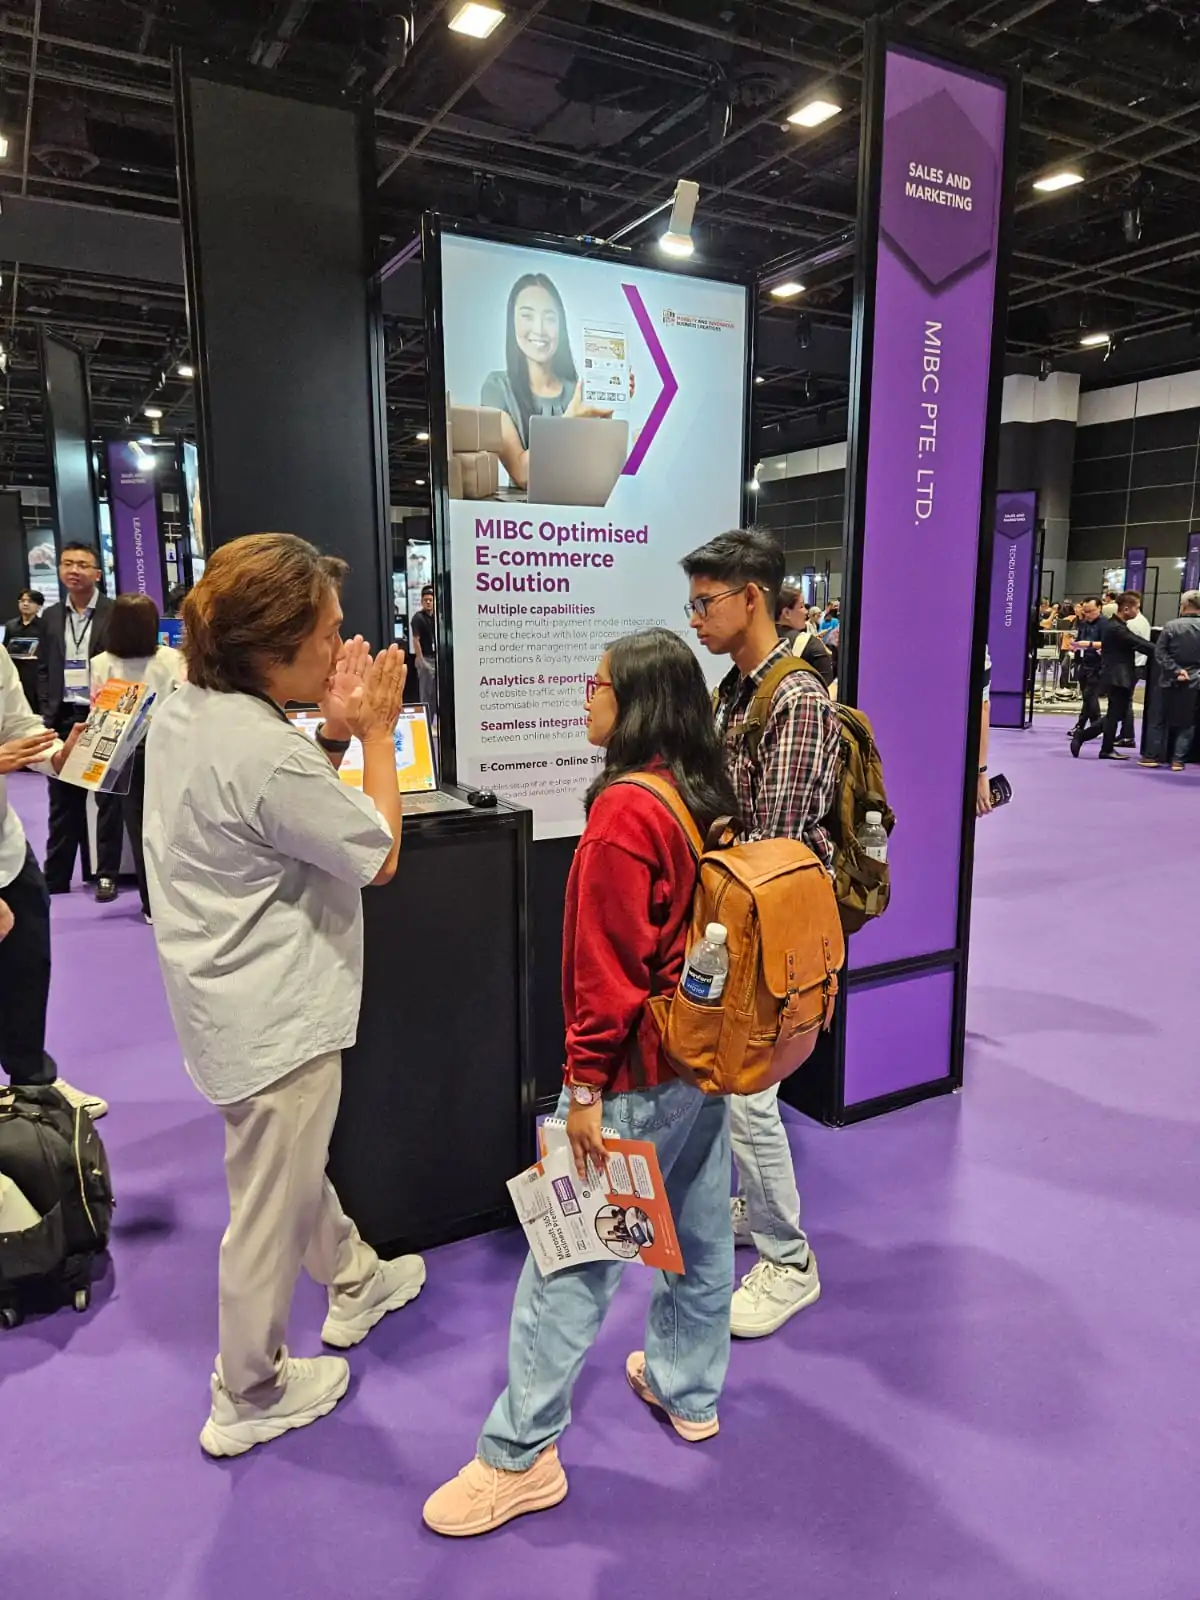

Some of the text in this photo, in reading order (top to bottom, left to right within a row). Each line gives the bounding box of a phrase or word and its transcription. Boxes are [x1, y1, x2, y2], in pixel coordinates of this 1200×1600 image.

[908, 162, 972, 191] SALES AND
[905, 181, 973, 212] MARKETING
[914, 320, 943, 526] MIBC PTE. LTD.
[132, 517, 144, 557] LEADING
[475, 518, 649, 547] MIBC Optimised
[475, 545, 615, 568] E-commerce
[475, 570, 570, 593] Solution
[477, 603, 596, 616] Multiple capabilities
[477, 618, 523, 629] including
[593, 618, 620, 627] mode
[477, 631, 509, 640] secure
[509, 630, 551, 640] checkout
[552, 629, 572, 639] with
[572, 629, 589, 639] low
[478, 643, 497, 652] and
[499, 643, 525, 652] order
[526, 642, 588, 653] management
[479, 654, 534, 666] promotions
[535, 654, 542, 663] &
[543, 653, 574, 665] loyalty
[479, 674, 535, 688] Analytics
[537, 674, 545, 684] &
[480, 690, 489, 699] of
[490, 688, 528, 698] website
[528, 686, 555, 697] traffic
[556, 686, 576, 696] with
[480, 700, 540, 711] customisable
[541, 699, 571, 709] metric
[480, 716, 588, 732] Seamless integrati
[481, 729, 586, 744] between online shop an
[480, 760, 548, 773] E-Commerce
[555, 756, 589, 767] Online
[590, 754, 606, 764] Sh
[548, 1227, 565, 1261] Microsoft
[556, 1227, 572, 1259] Business
